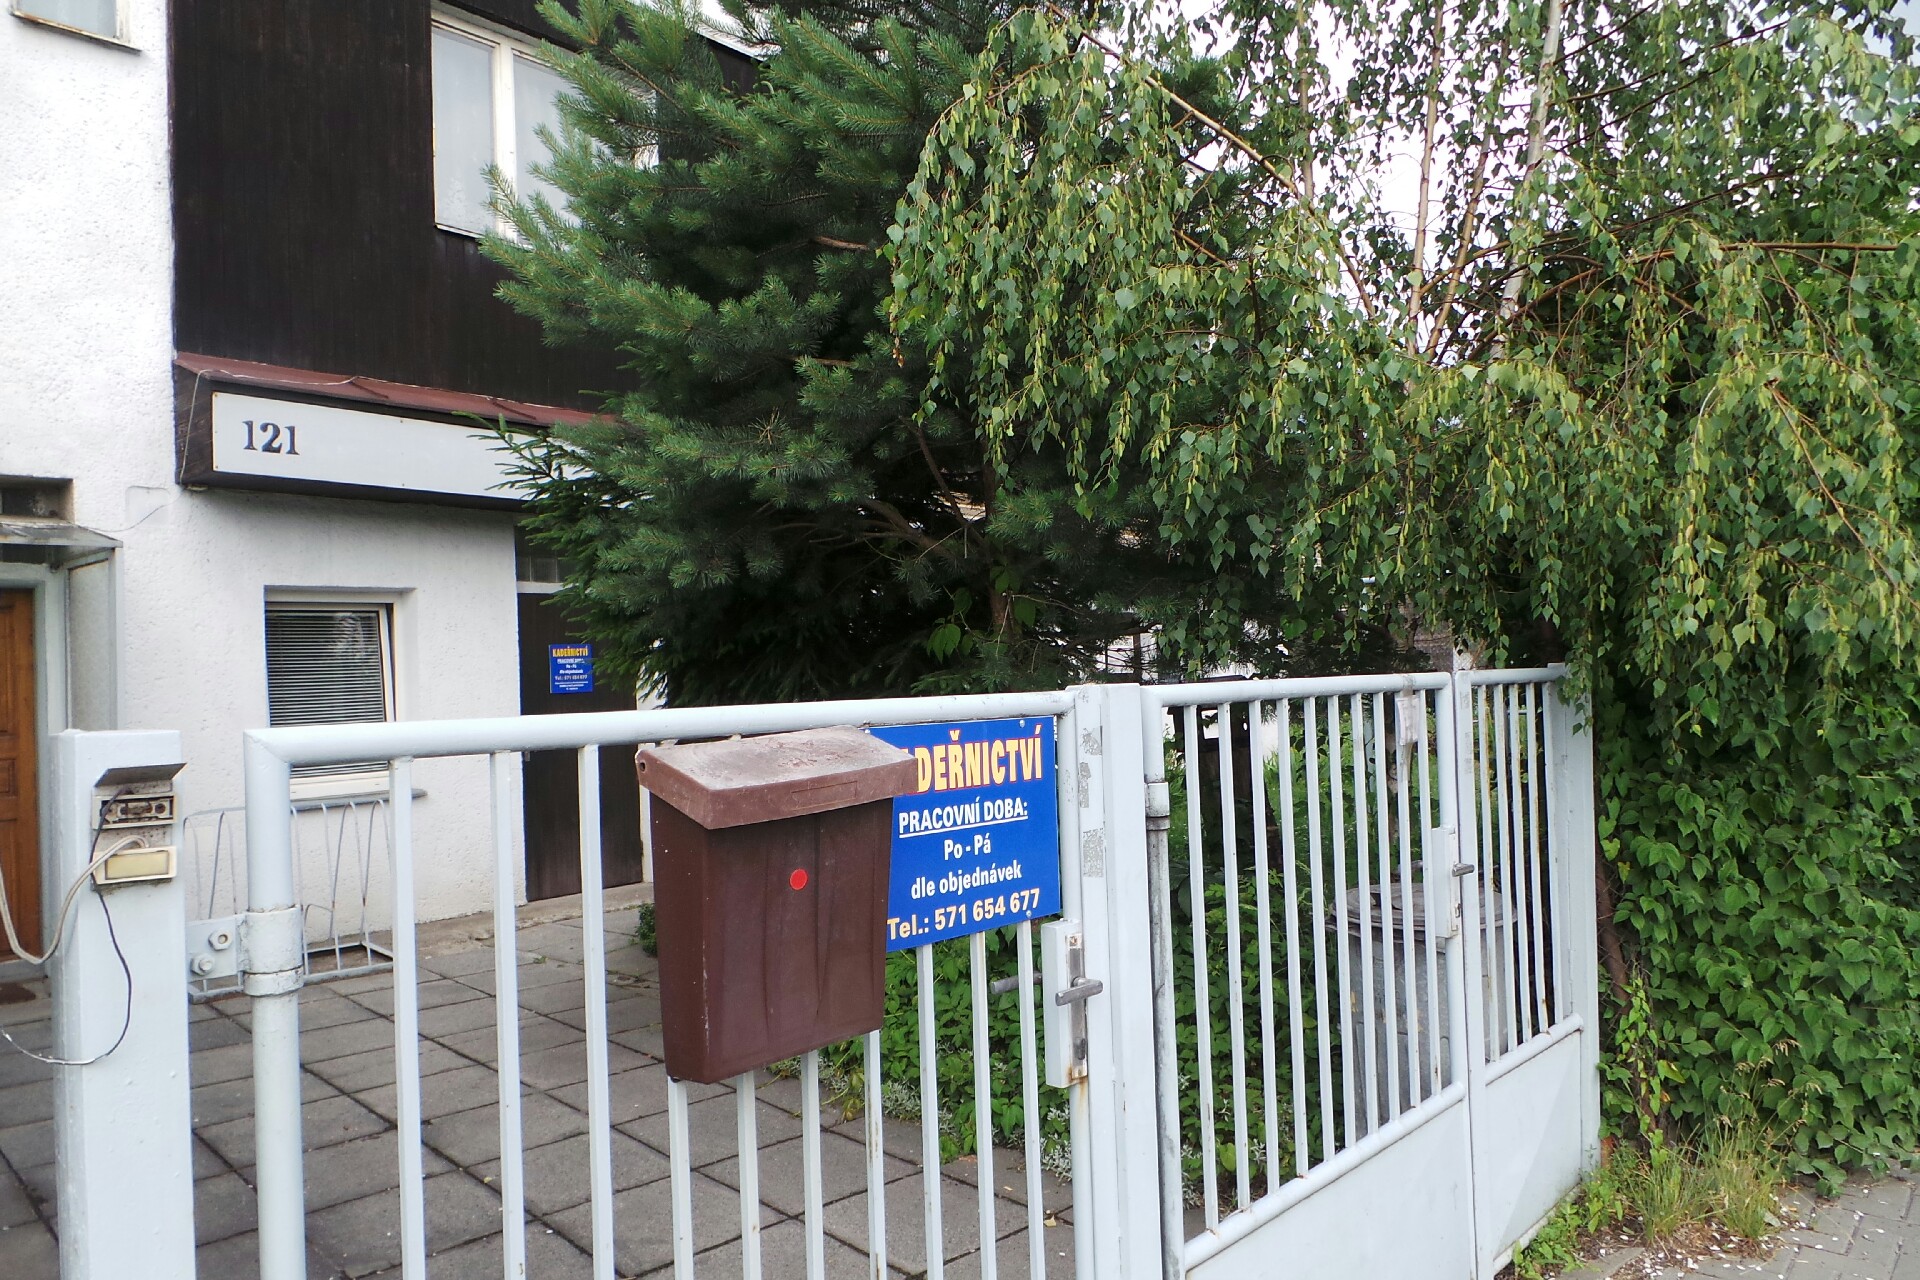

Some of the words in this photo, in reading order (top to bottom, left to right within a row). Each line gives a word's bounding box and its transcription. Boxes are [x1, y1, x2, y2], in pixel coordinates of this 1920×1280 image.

[243, 420, 300, 456] 121
[901, 724, 1043, 795] DEŘNICTVÍ
[898, 796, 981, 834] PRACOVNÍ
[983, 797, 1028, 823] DOBA:
[944, 839, 963, 860] Po
[973, 833, 992, 855] Pá
[911, 877, 936, 900] dle
[939, 859, 1022, 895] objednávek
[887, 917, 930, 940] Tel.:
[934, 903, 967, 931] 571
[972, 897, 1006, 921] 654
[1009, 888, 1040, 913] 677
